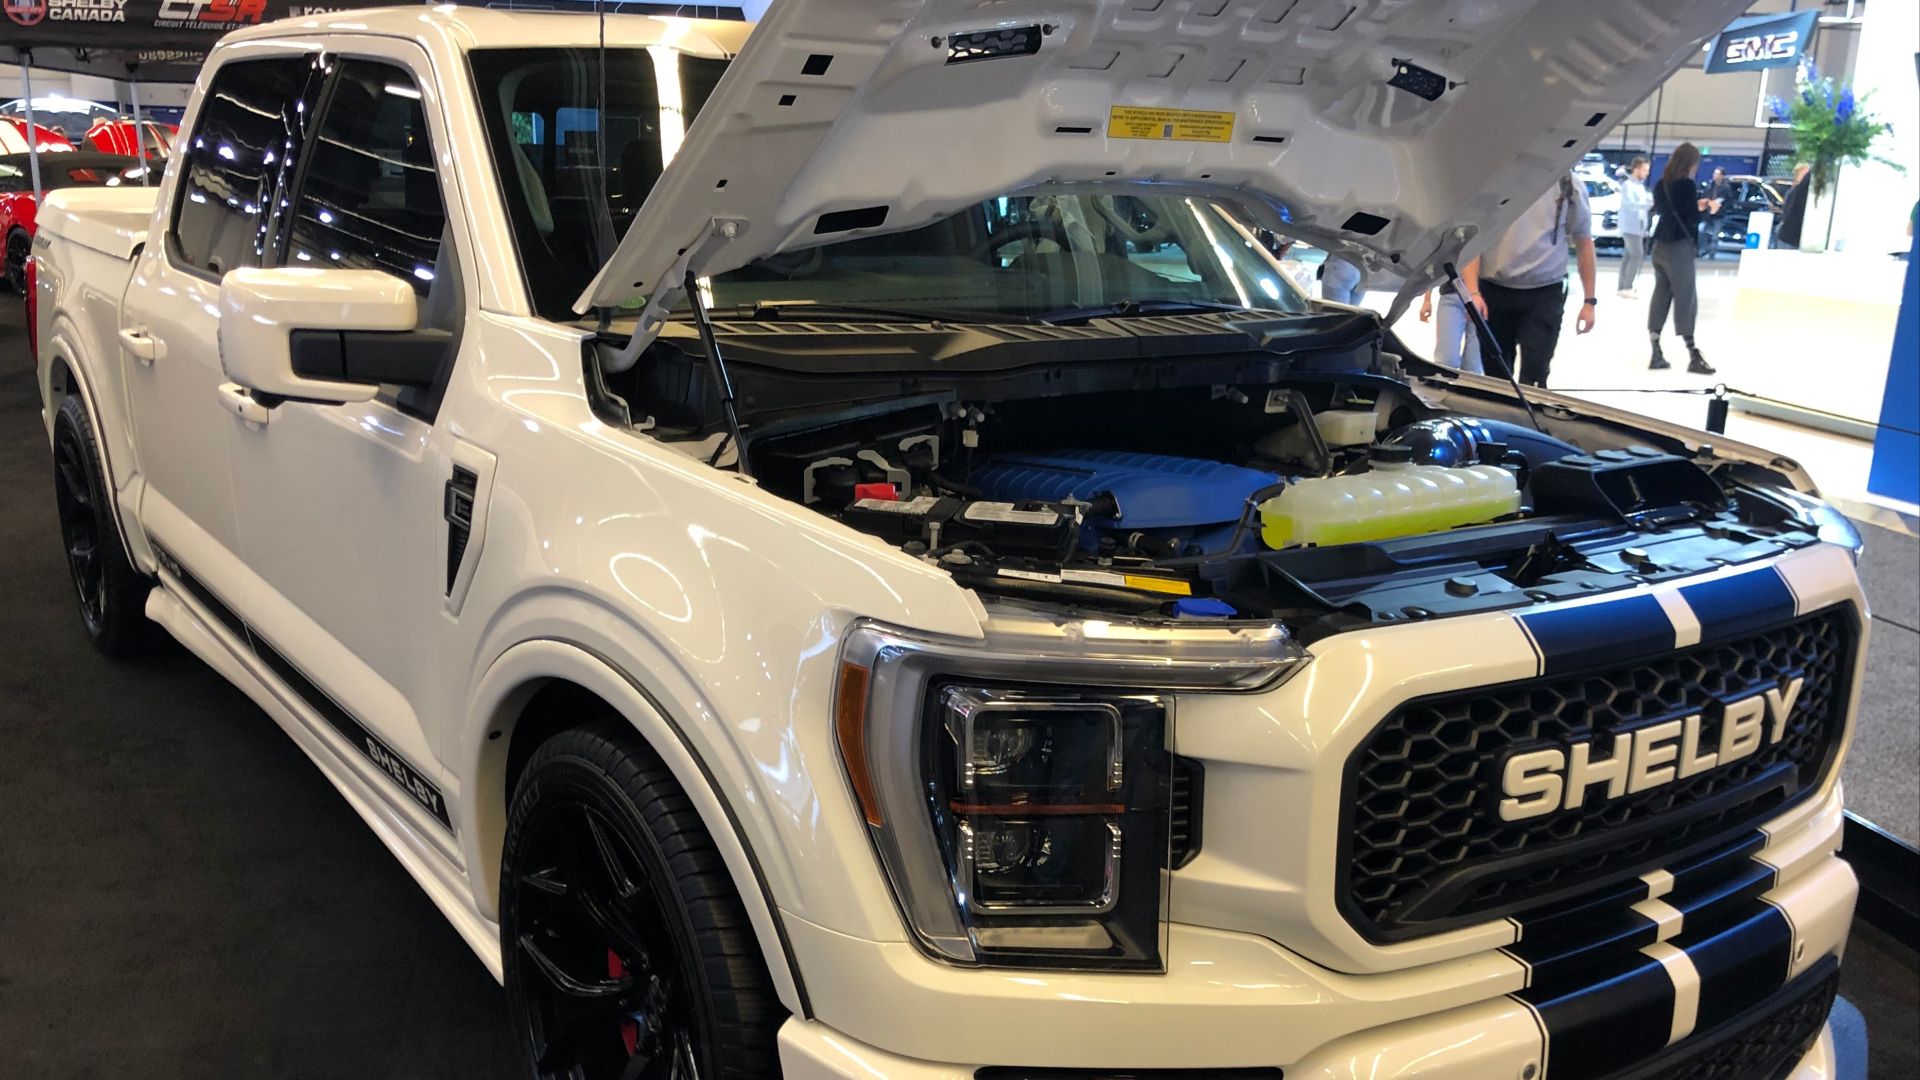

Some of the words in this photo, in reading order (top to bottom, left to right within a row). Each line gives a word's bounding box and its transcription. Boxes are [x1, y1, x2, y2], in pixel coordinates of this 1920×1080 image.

[49, 8, 125, 22] CANADA
[153, 19, 184, 29] CIRCUIT
[1500, 677, 1804, 822] SHELBY
[366, 737, 438, 813] SHELBY
